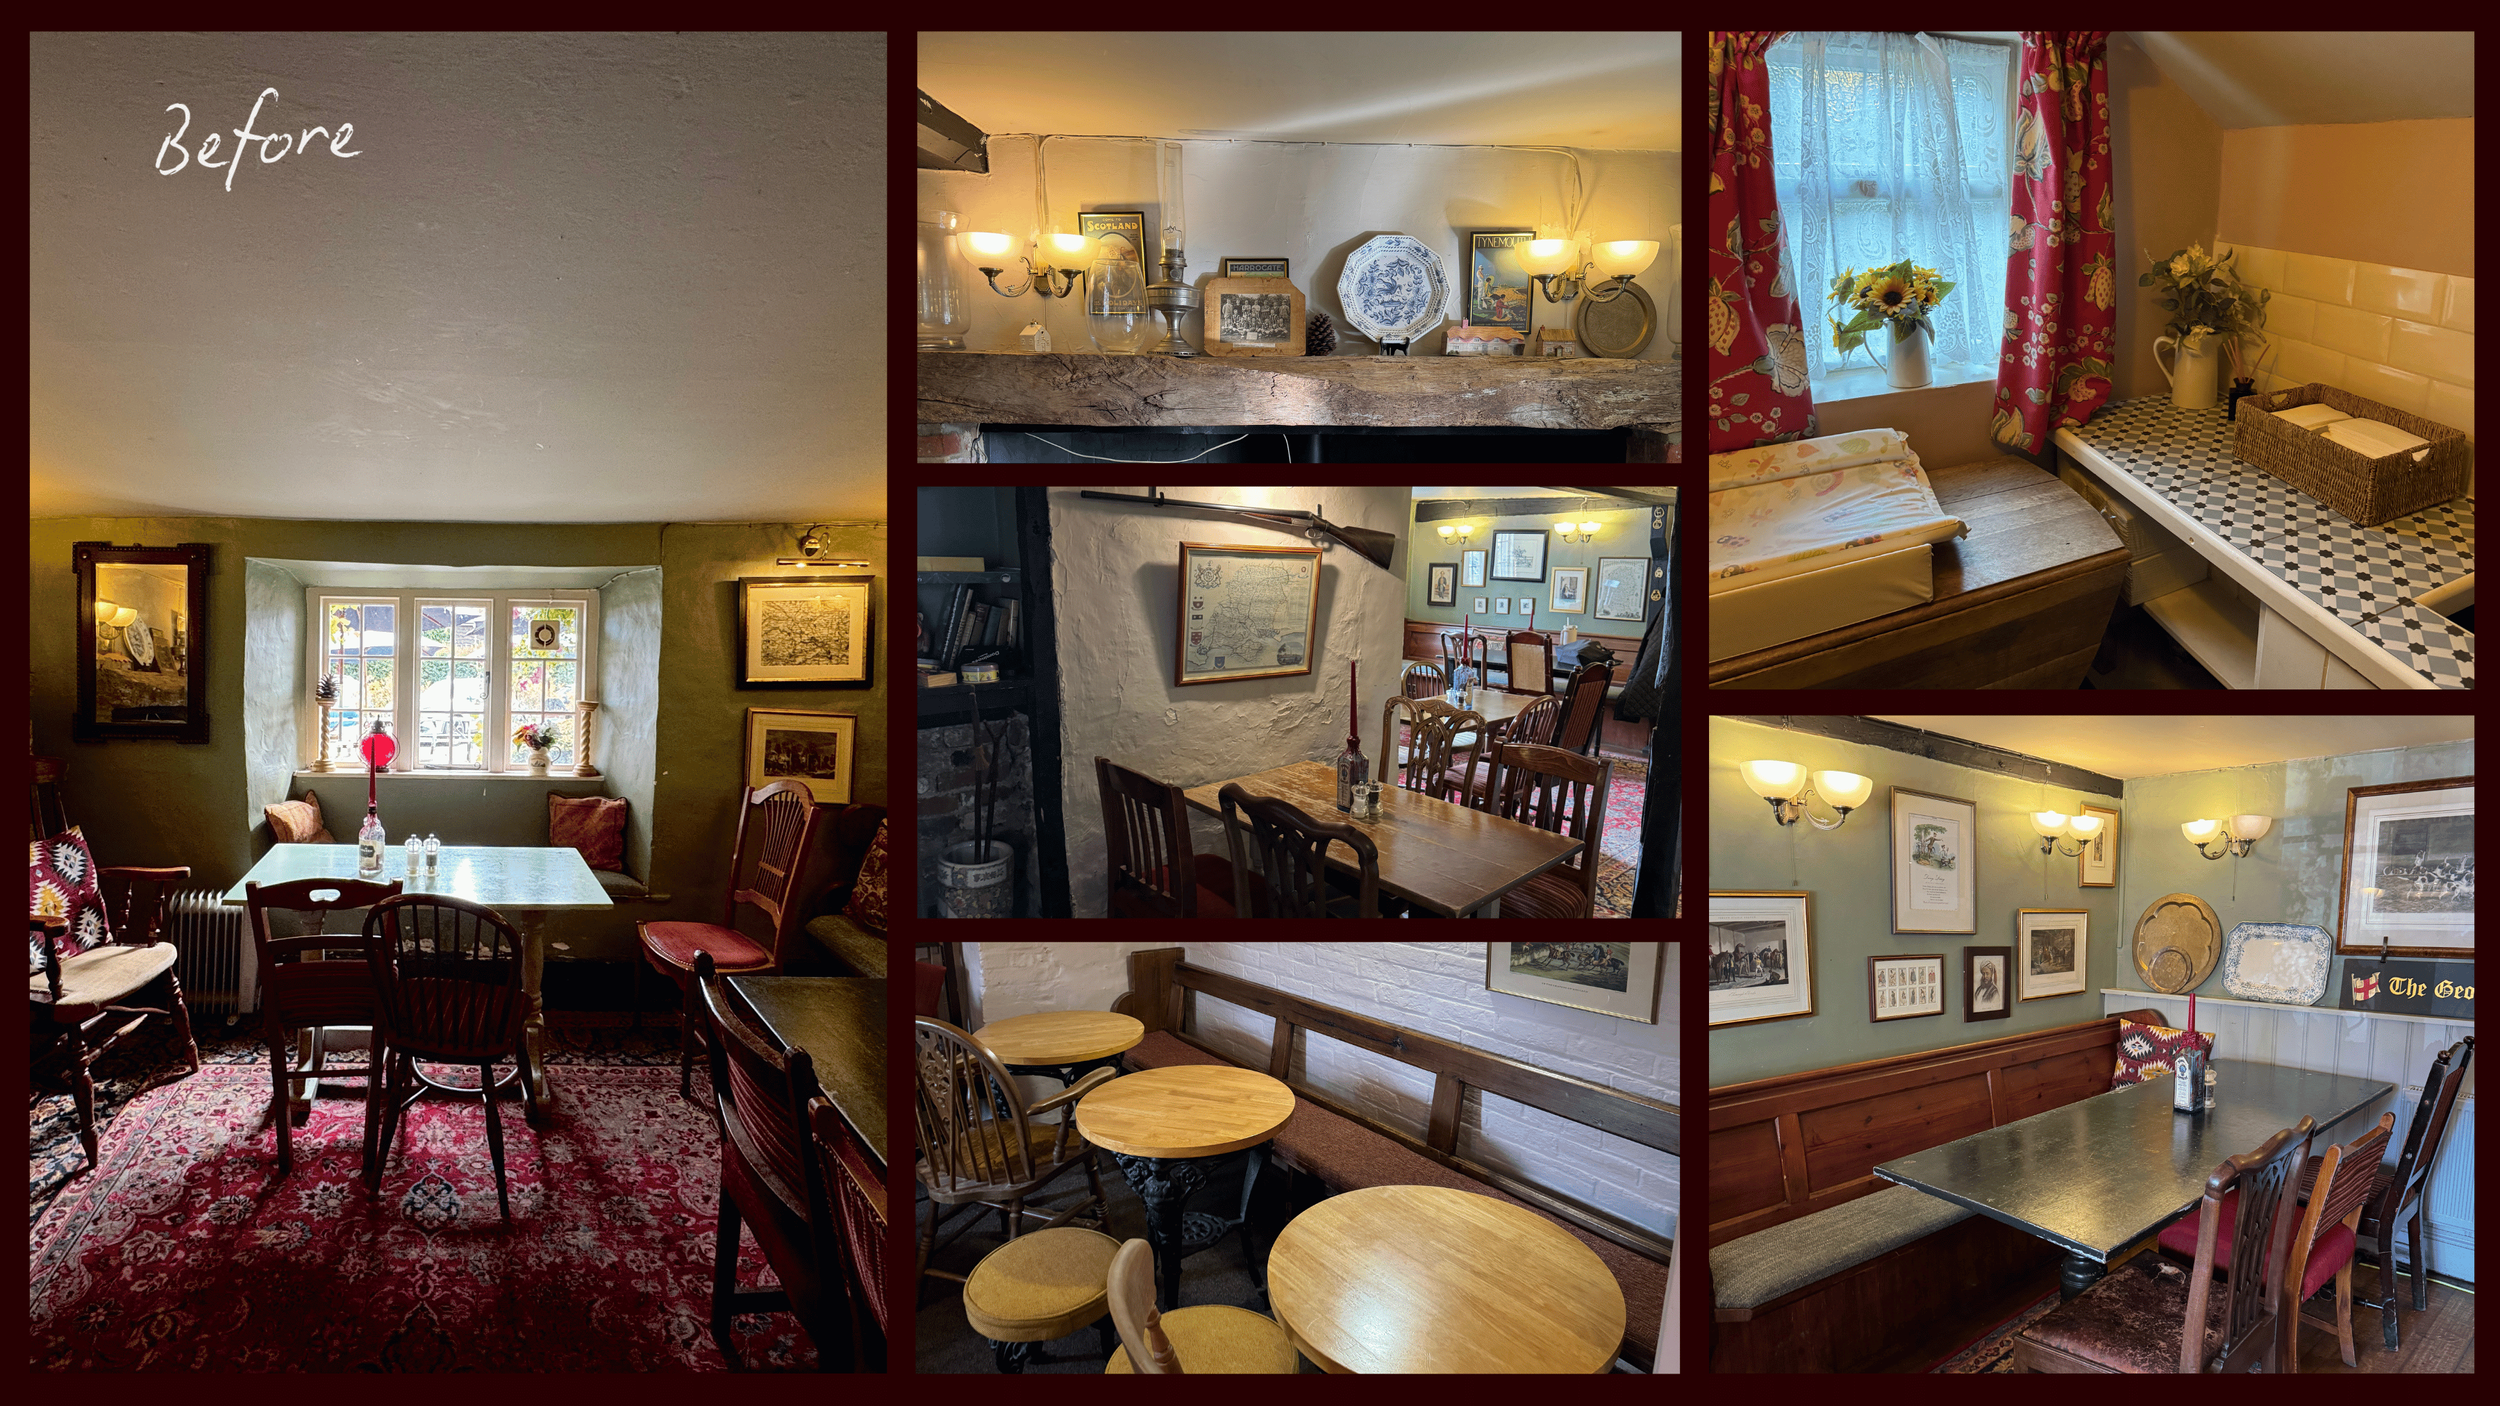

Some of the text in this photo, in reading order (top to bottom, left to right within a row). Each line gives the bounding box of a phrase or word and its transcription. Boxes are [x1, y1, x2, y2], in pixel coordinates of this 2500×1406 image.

[1086, 220, 1139, 232] SCOTLAND
[1233, 264, 1282, 272] HARROGATE
[2389, 977, 2475, 1000] The Geo
